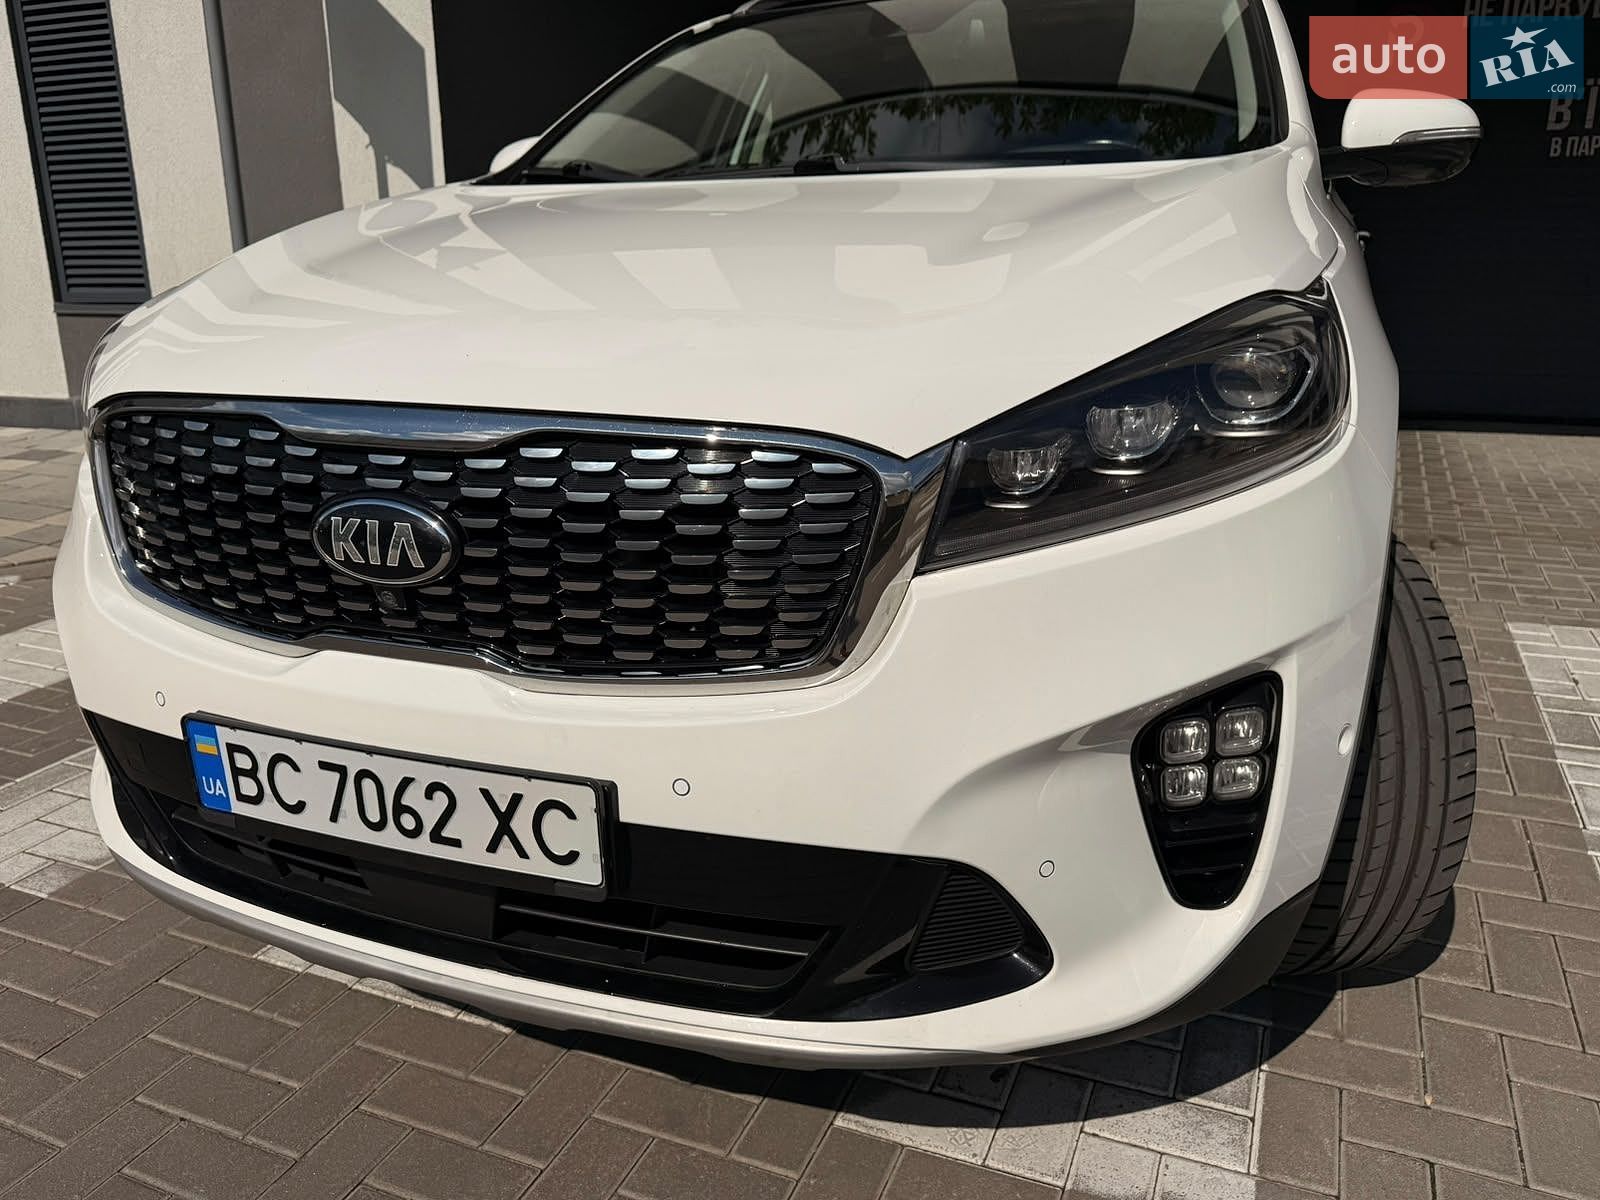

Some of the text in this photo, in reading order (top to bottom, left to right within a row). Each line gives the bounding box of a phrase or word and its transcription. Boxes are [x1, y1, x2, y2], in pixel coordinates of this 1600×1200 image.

[331, 516, 425, 568] KIA
[202, 776, 227, 798] UA
[225, 742, 580, 866] BC 7062 XC
